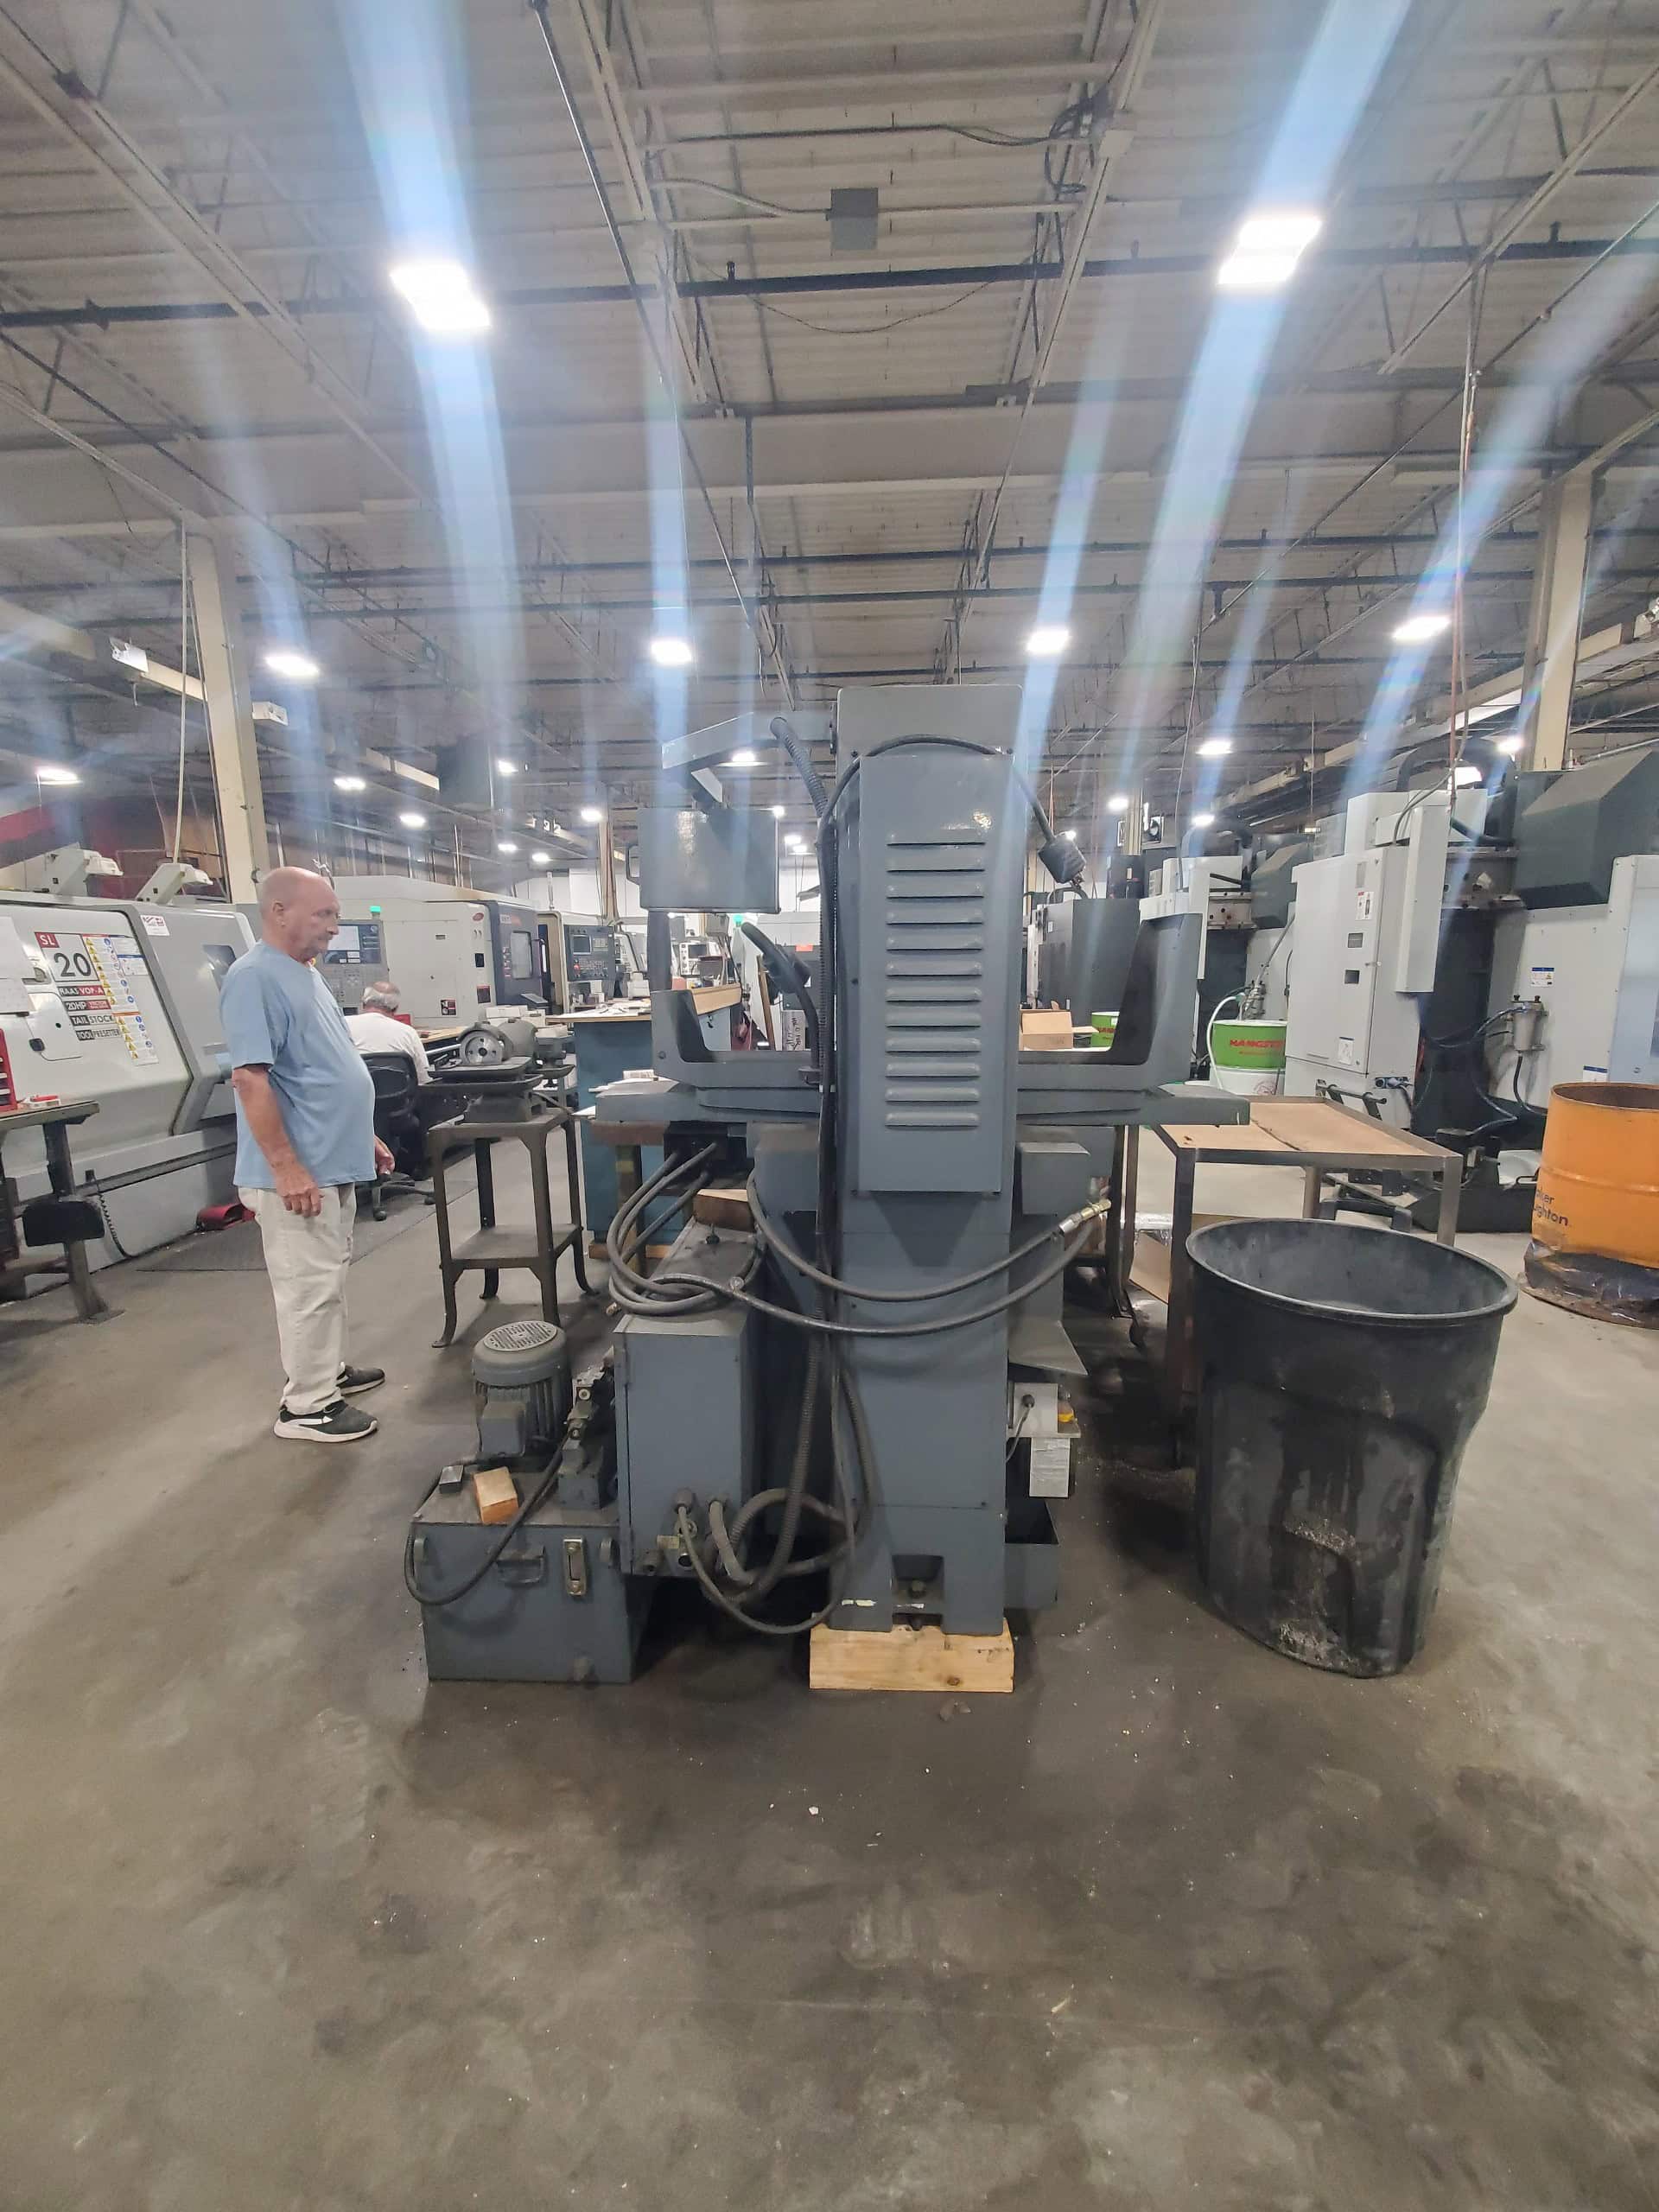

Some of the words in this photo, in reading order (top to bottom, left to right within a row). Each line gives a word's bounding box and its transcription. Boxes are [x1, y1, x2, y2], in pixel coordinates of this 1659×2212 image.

[40, 934, 55, 945] SL
[54, 952, 92, 977] 20
[66, 1001, 87, 1010] 20HP
[71, 1014, 89, 1025] TAIL
[88, 1014, 116, 1024] STOCK
